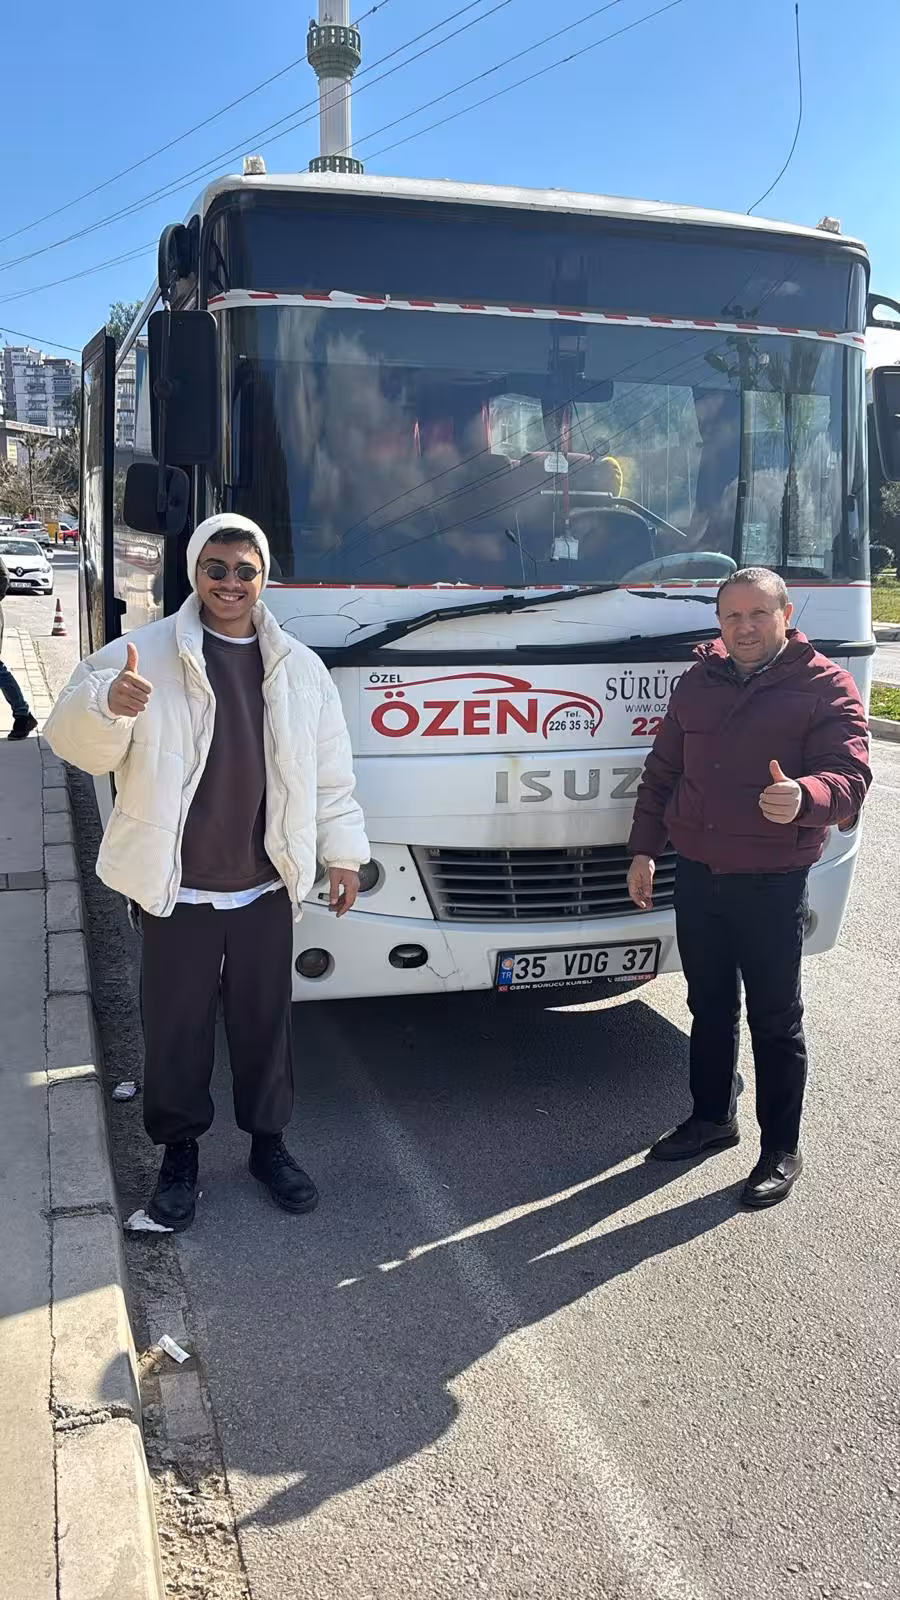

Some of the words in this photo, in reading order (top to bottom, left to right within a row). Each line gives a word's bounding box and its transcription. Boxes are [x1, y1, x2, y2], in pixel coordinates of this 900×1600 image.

[369, 672, 404, 683] ÖZEL
[371, 691, 538, 737] ÖZEN
[564, 710, 581, 718] Tel.
[549, 720, 567, 731] 226
[569, 720, 581, 730] 35
[583, 719, 595, 730] 35
[515, 956, 547, 980] 35
[564, 951, 609, 976] VDG
[622, 948, 653, 971] 37
[501, 971, 512, 979] TR
